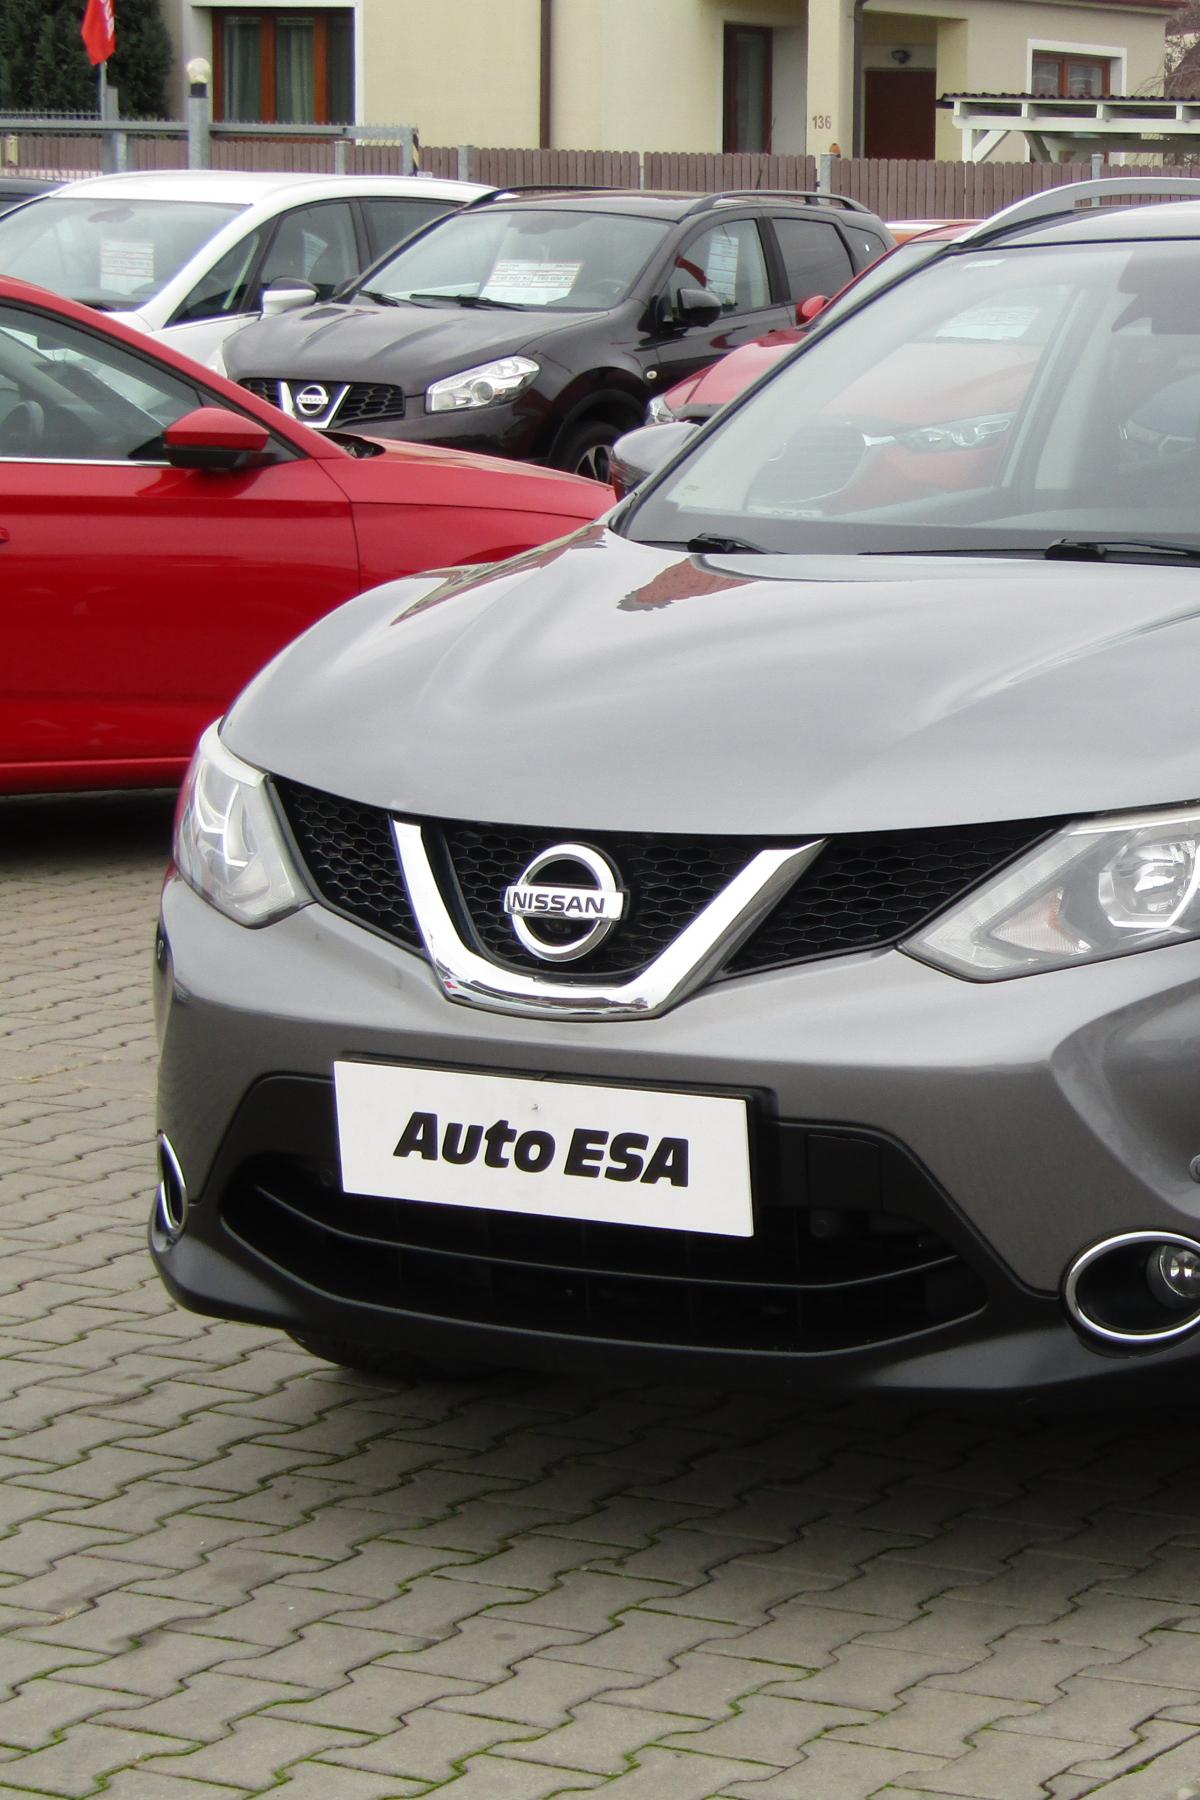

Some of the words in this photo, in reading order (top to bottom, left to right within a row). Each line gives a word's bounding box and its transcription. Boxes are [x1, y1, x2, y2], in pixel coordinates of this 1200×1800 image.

[812, 115, 831, 130] 136
[512, 891, 606, 914] NISSAN
[393, 1111, 556, 1173] Auto
[563, 1127, 690, 1188] ESA
